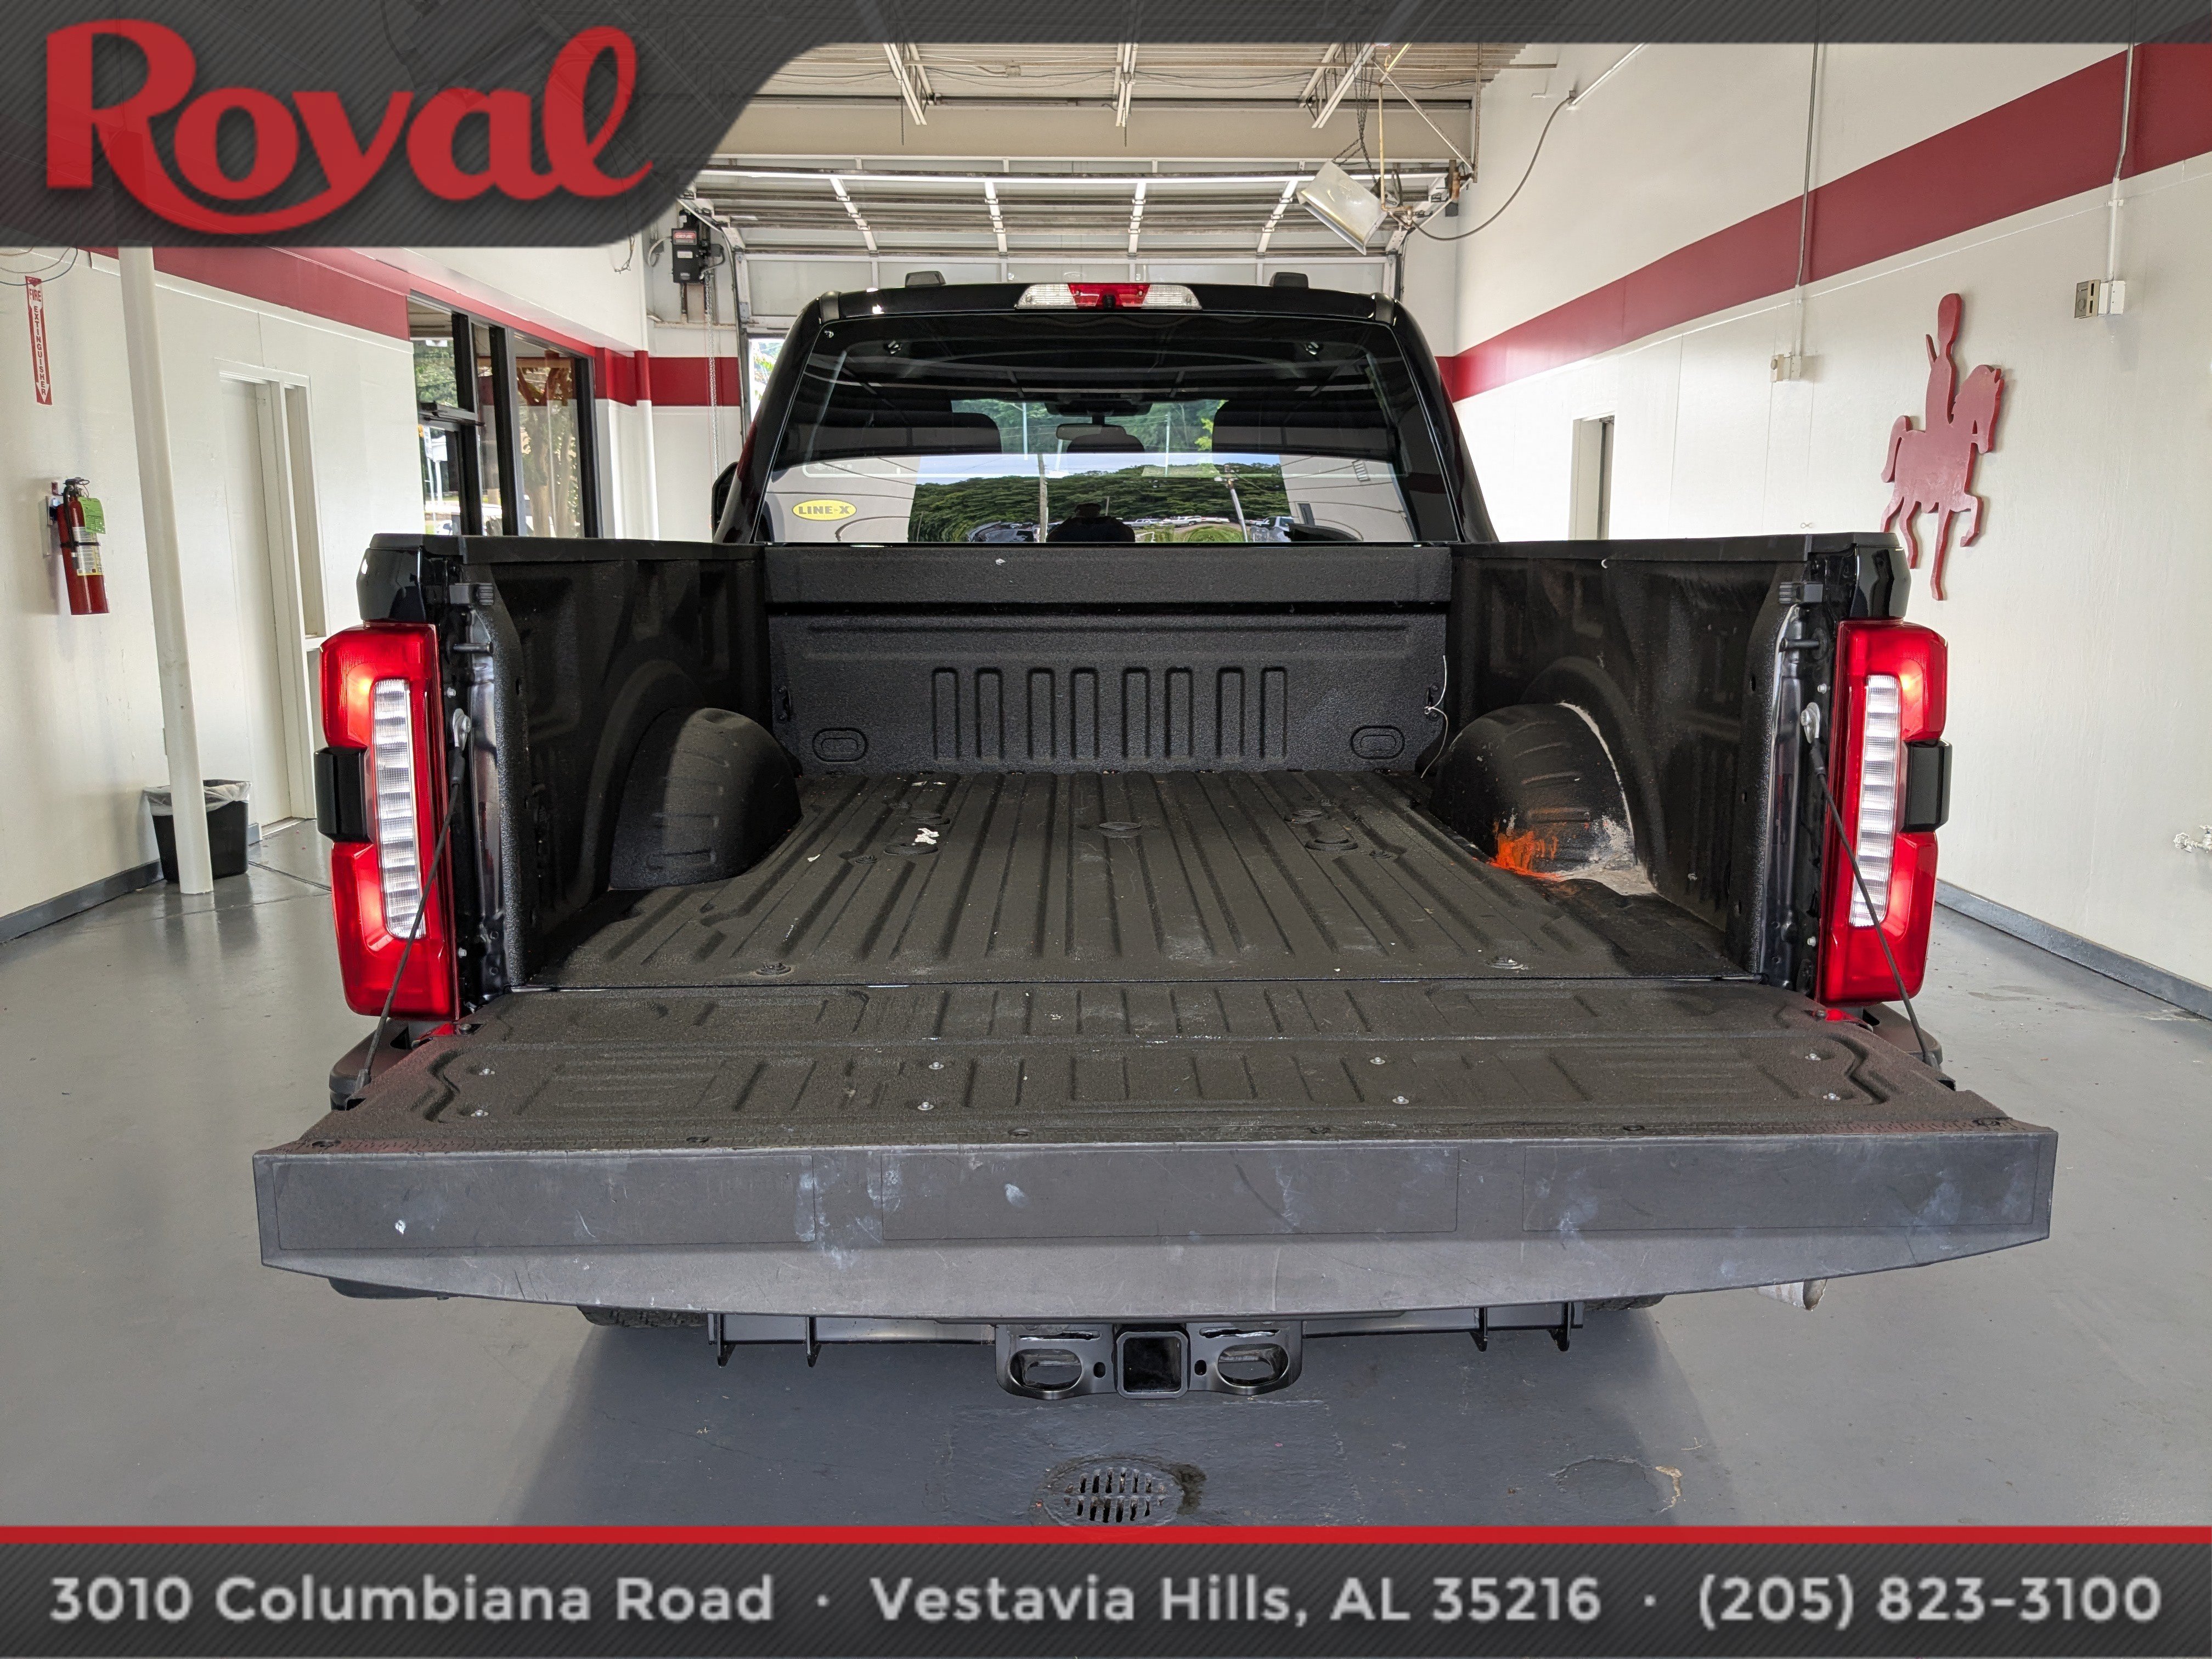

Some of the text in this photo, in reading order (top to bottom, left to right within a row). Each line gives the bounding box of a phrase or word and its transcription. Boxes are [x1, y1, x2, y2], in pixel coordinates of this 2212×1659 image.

[29, 288, 42, 302] FIRE
[34, 306, 46, 396] EXTINGUISHER
[798, 506, 850, 515] LINE-X
